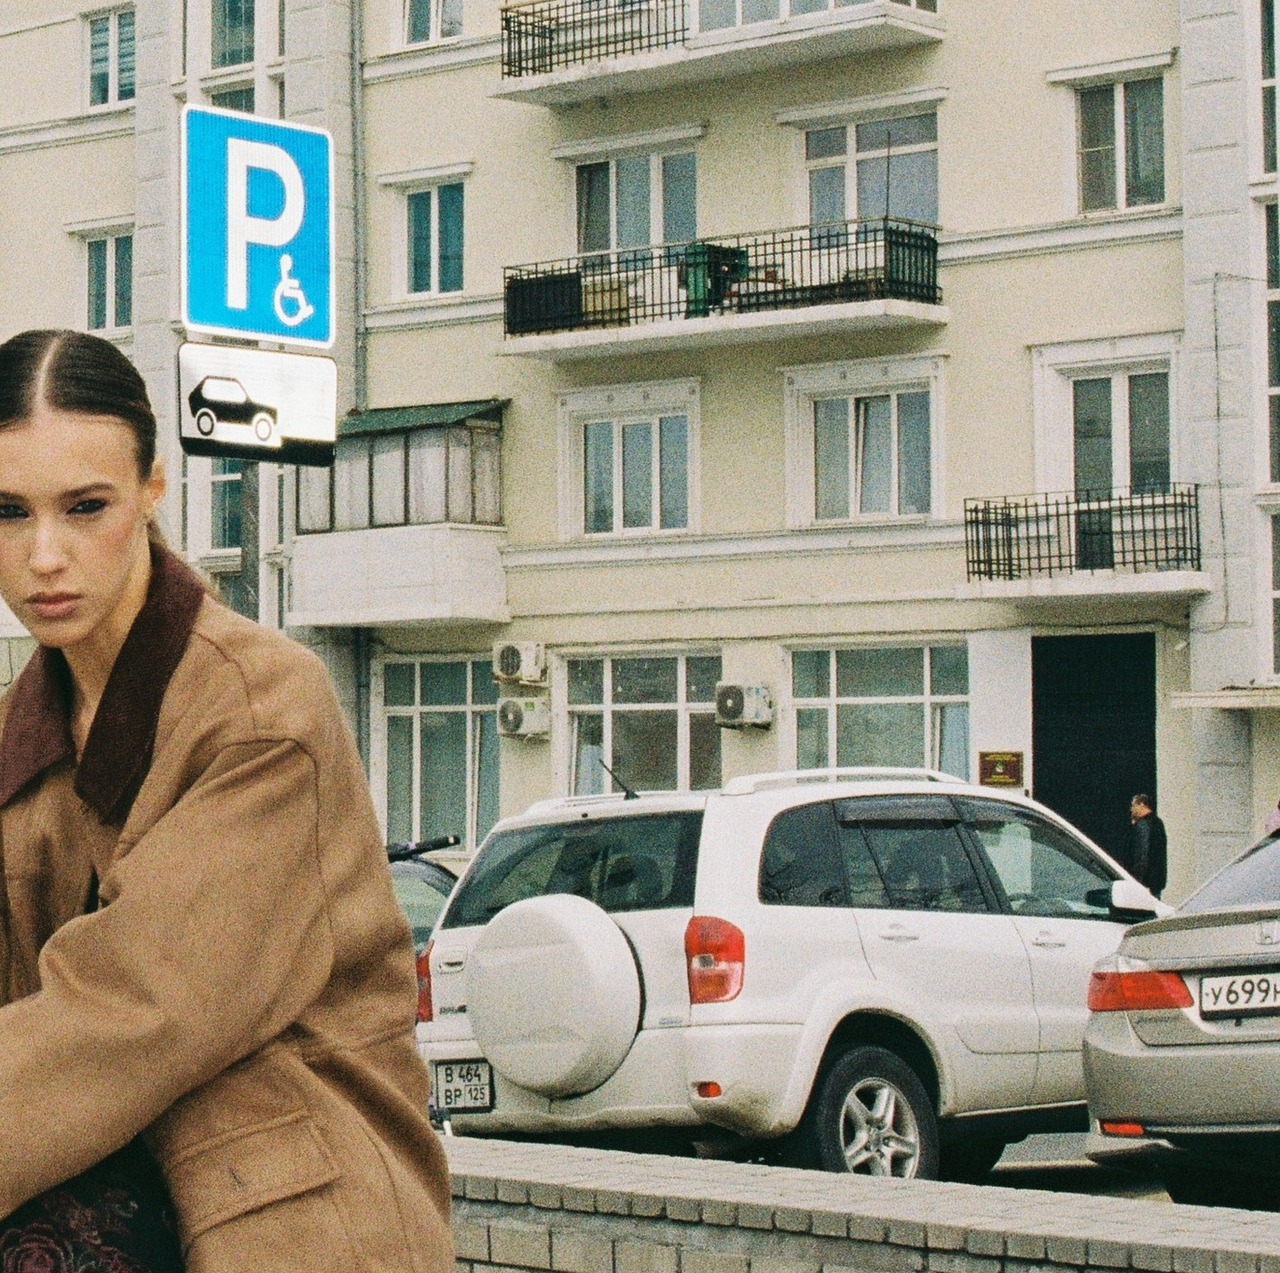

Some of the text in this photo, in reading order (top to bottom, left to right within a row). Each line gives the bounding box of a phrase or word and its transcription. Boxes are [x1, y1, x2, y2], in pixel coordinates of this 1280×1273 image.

[226, 136, 306, 310] P
[445, 1066, 481, 1083] В 464
[445, 1088, 485, 1105] ВР 125
